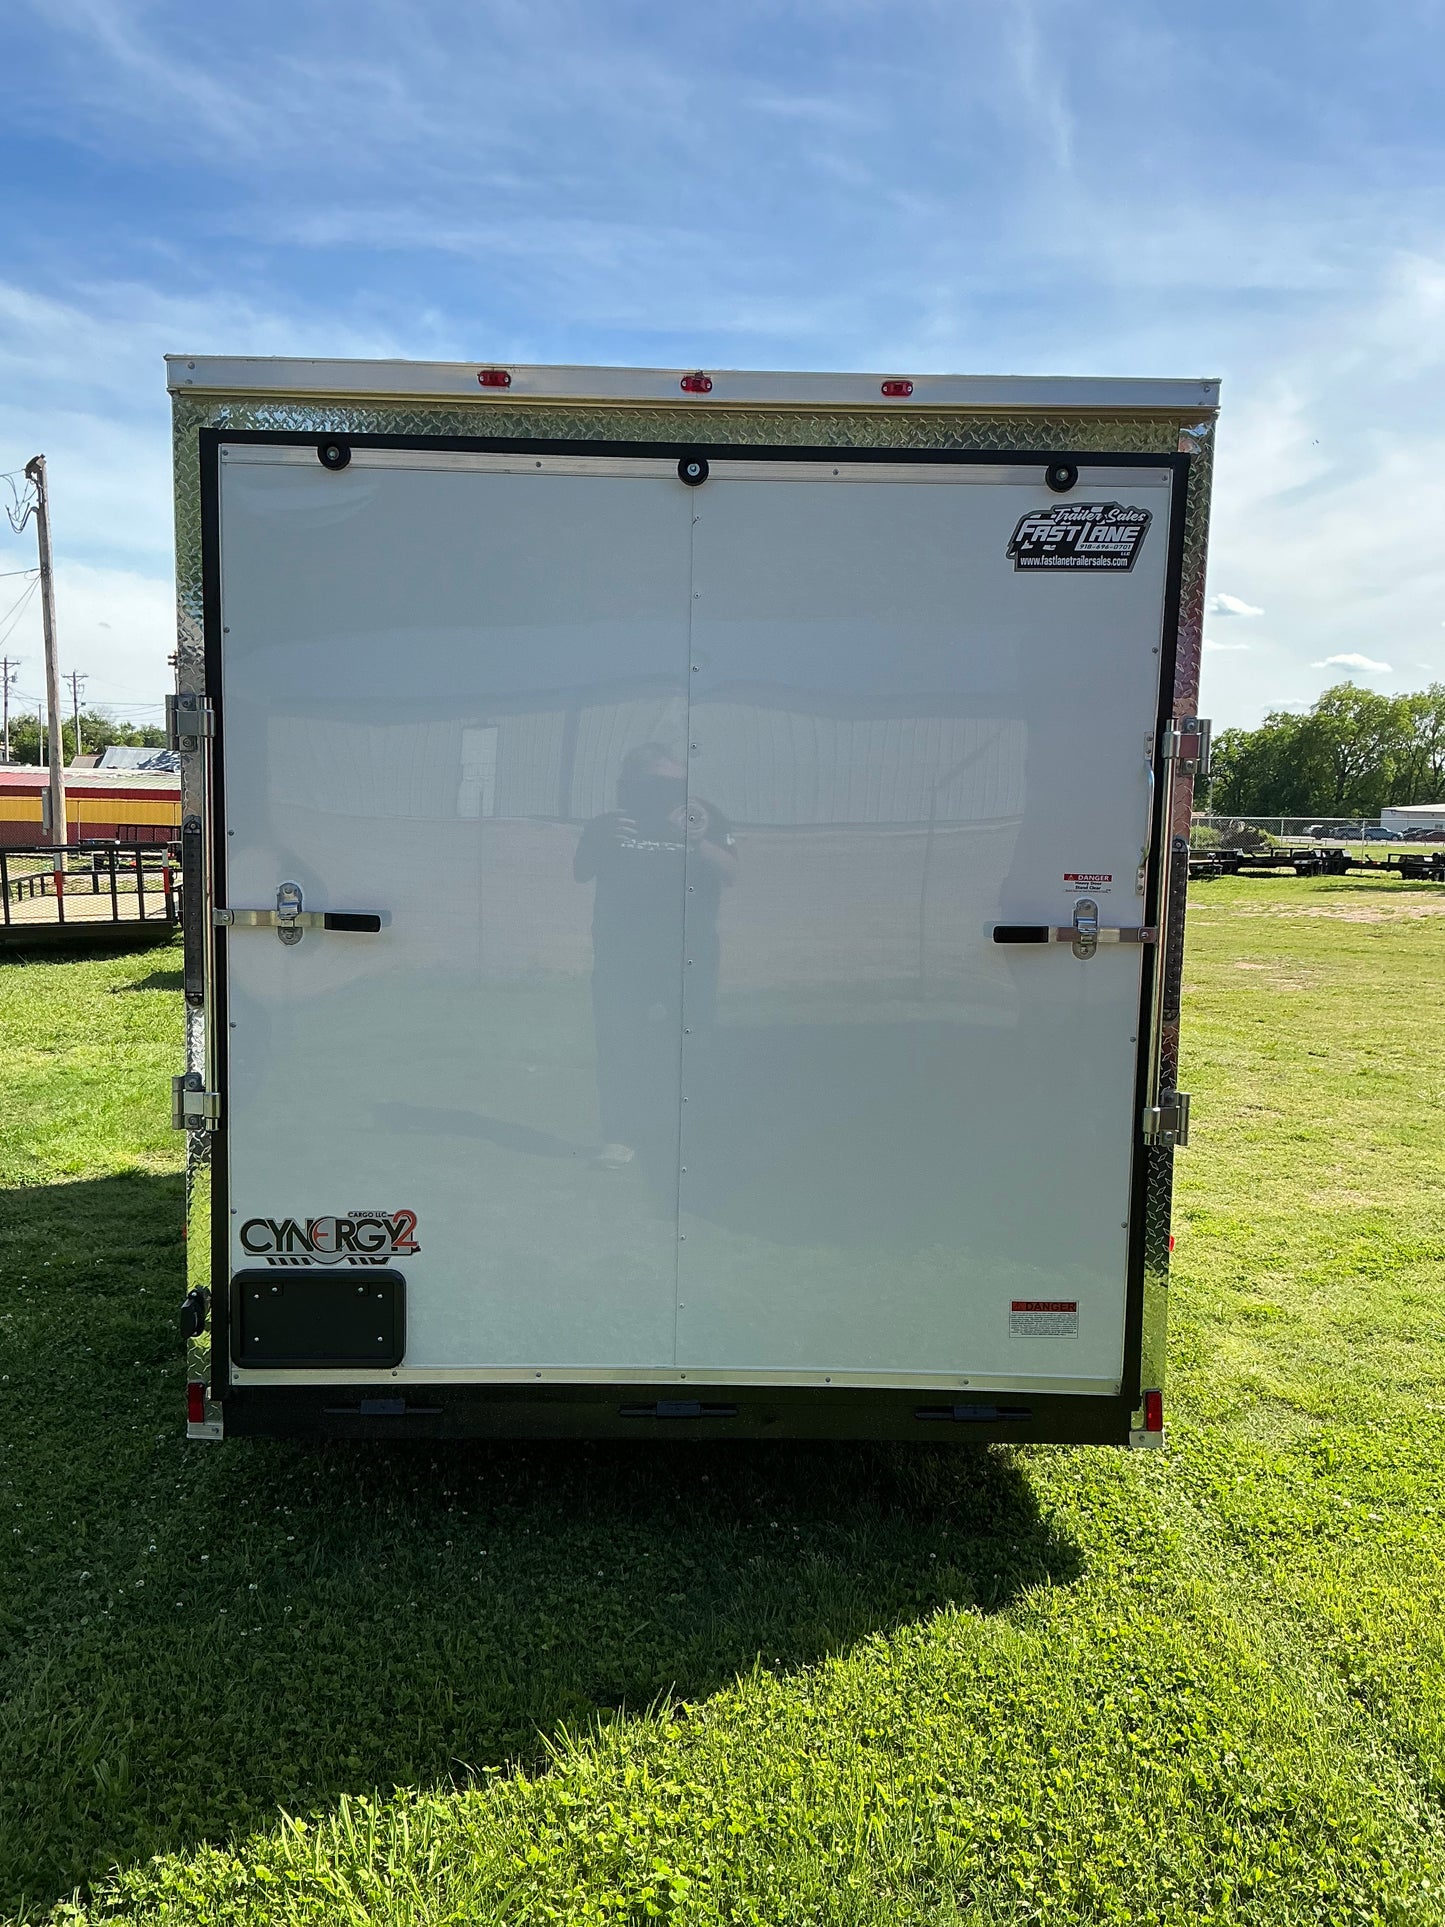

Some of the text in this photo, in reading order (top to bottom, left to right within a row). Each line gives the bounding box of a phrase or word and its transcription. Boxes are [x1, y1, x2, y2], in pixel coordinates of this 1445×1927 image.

[1053, 508, 1146, 523] Trailer Sales
[1020, 555, 1128, 567] www.fastlanetrailersales.com
[1026, 1302, 1076, 1311] DANGER
